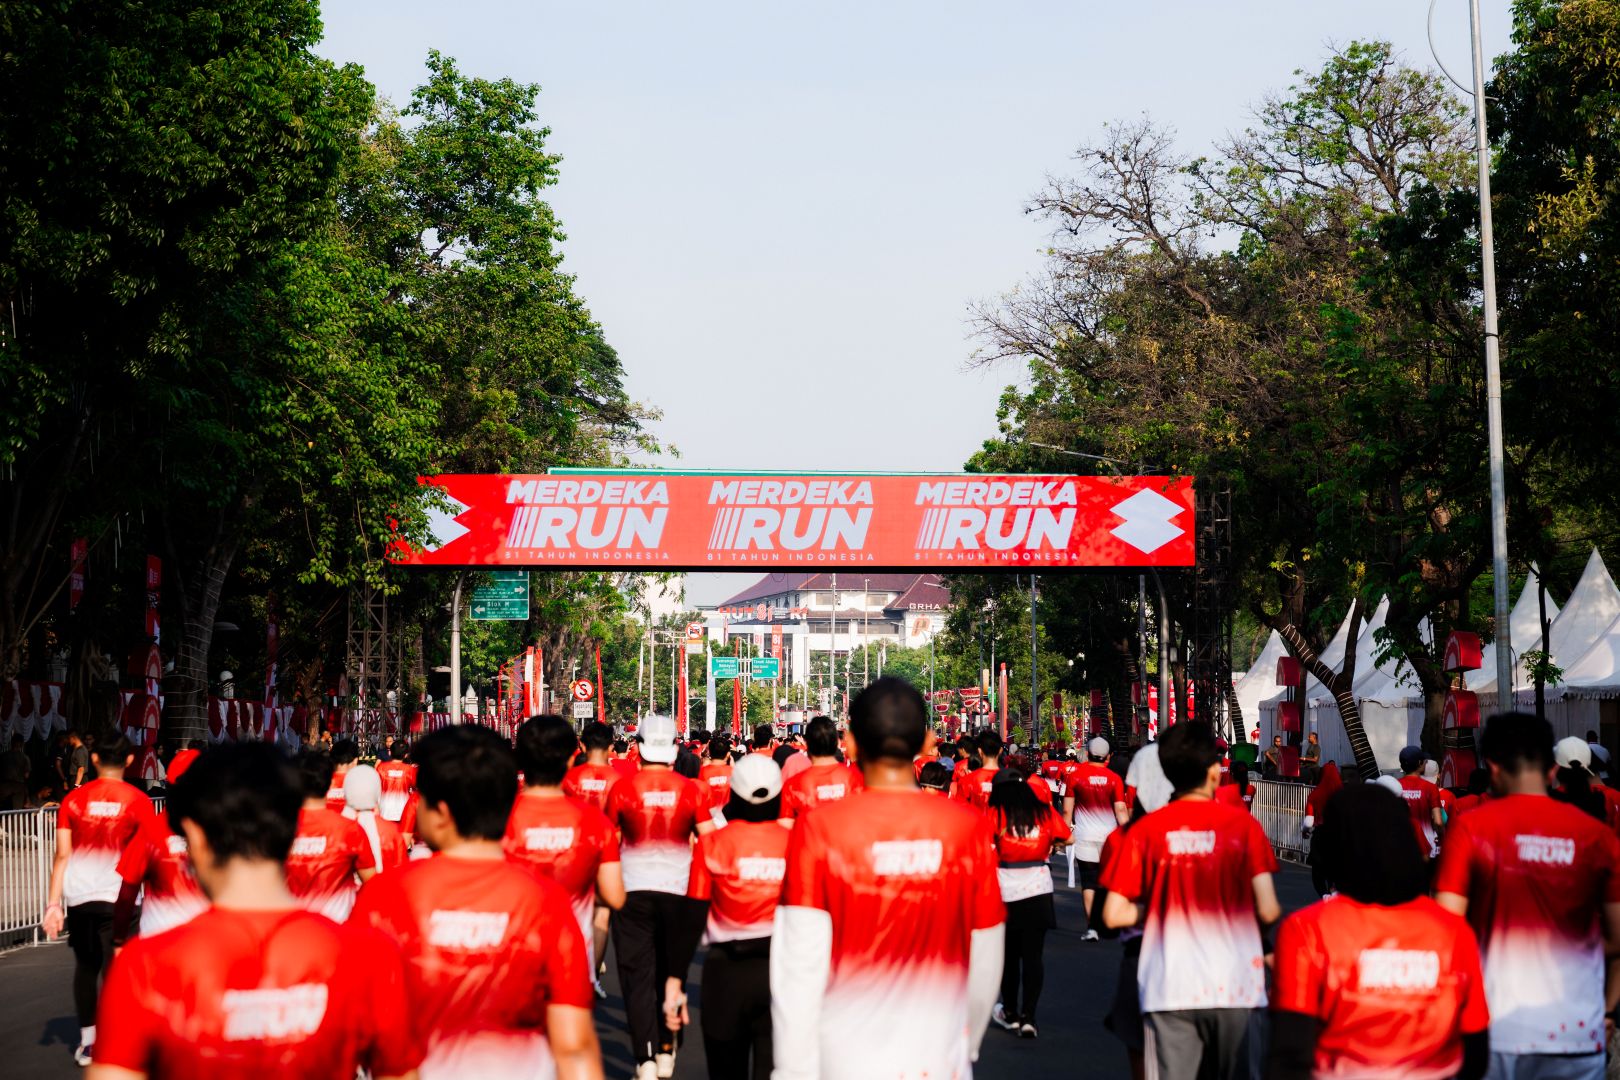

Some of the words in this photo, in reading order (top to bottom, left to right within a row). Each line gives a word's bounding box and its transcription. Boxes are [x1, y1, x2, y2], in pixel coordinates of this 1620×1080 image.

[506, 480, 669, 505] MERDEKA
[707, 481, 874, 505] MERDEKA
[914, 482, 1078, 505] MERDEKA
[530, 507, 669, 549] RUN
[733, 507, 874, 550] RUN
[940, 507, 1078, 550] RUN
[528, 551, 577, 560] TAHUN
[584, 551, 670, 560] INDONESIA
[731, 553, 780, 561] TAHUN
[788, 553, 875, 561] INDONESIA
[937, 552, 986, 561] TAHUN
[994, 552, 1079, 561] INDONESIA
[719, 607, 755, 620] HUT
[909, 602, 941, 610] GRHA
